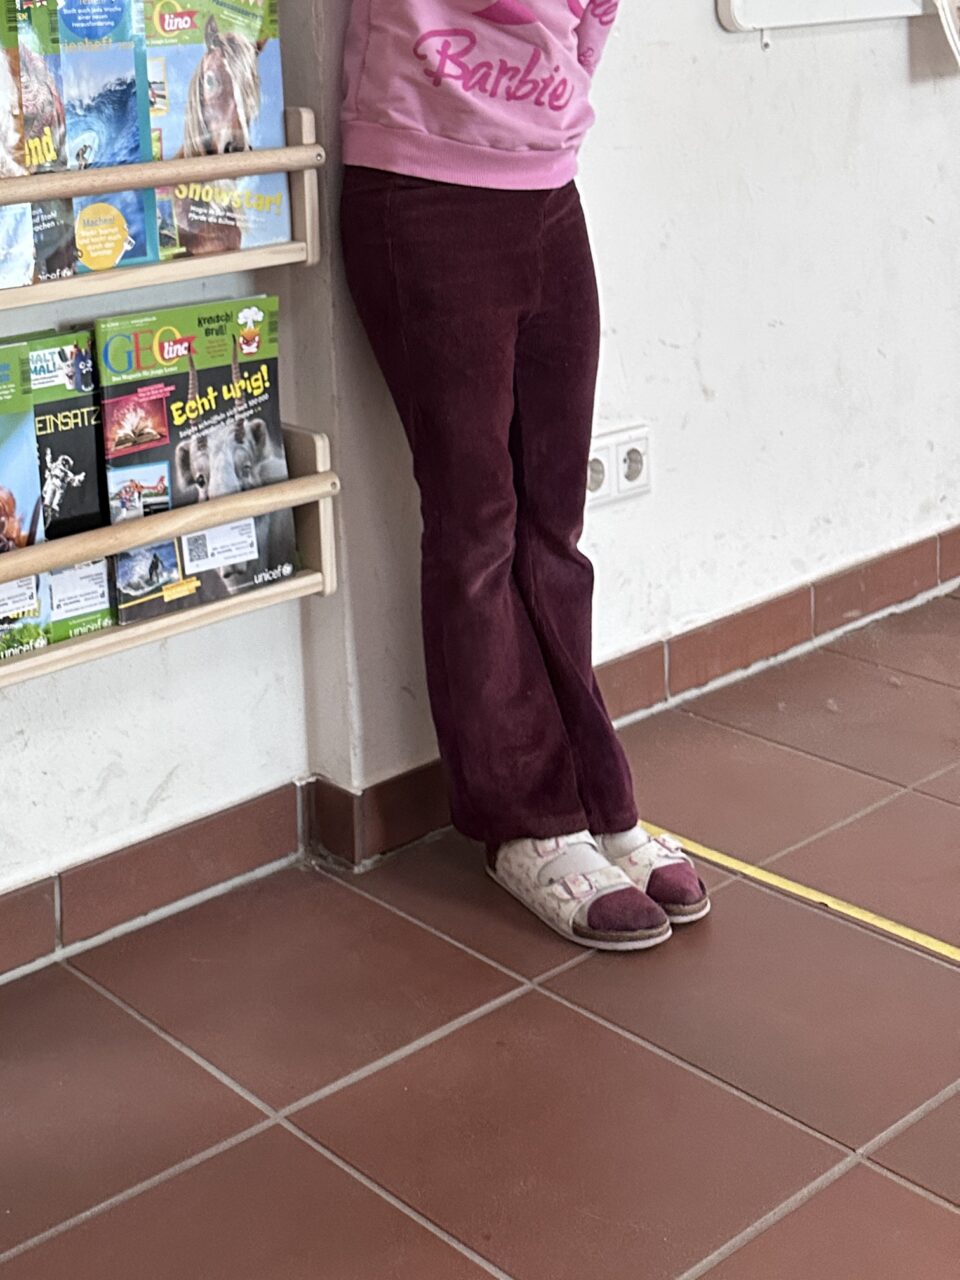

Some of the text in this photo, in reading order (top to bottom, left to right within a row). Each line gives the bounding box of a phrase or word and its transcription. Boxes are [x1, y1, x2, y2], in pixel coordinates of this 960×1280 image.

[164, 13, 191, 30] lino
[413, 28, 575, 112] Barbie
[175, 183, 283, 216] Snowstar!
[102, 326, 183, 375] GEO
[170, 364, 271, 425] Echt urig!
[36, 406, 101, 435] EINSATZ
[253, 564, 282, 584] unicef
